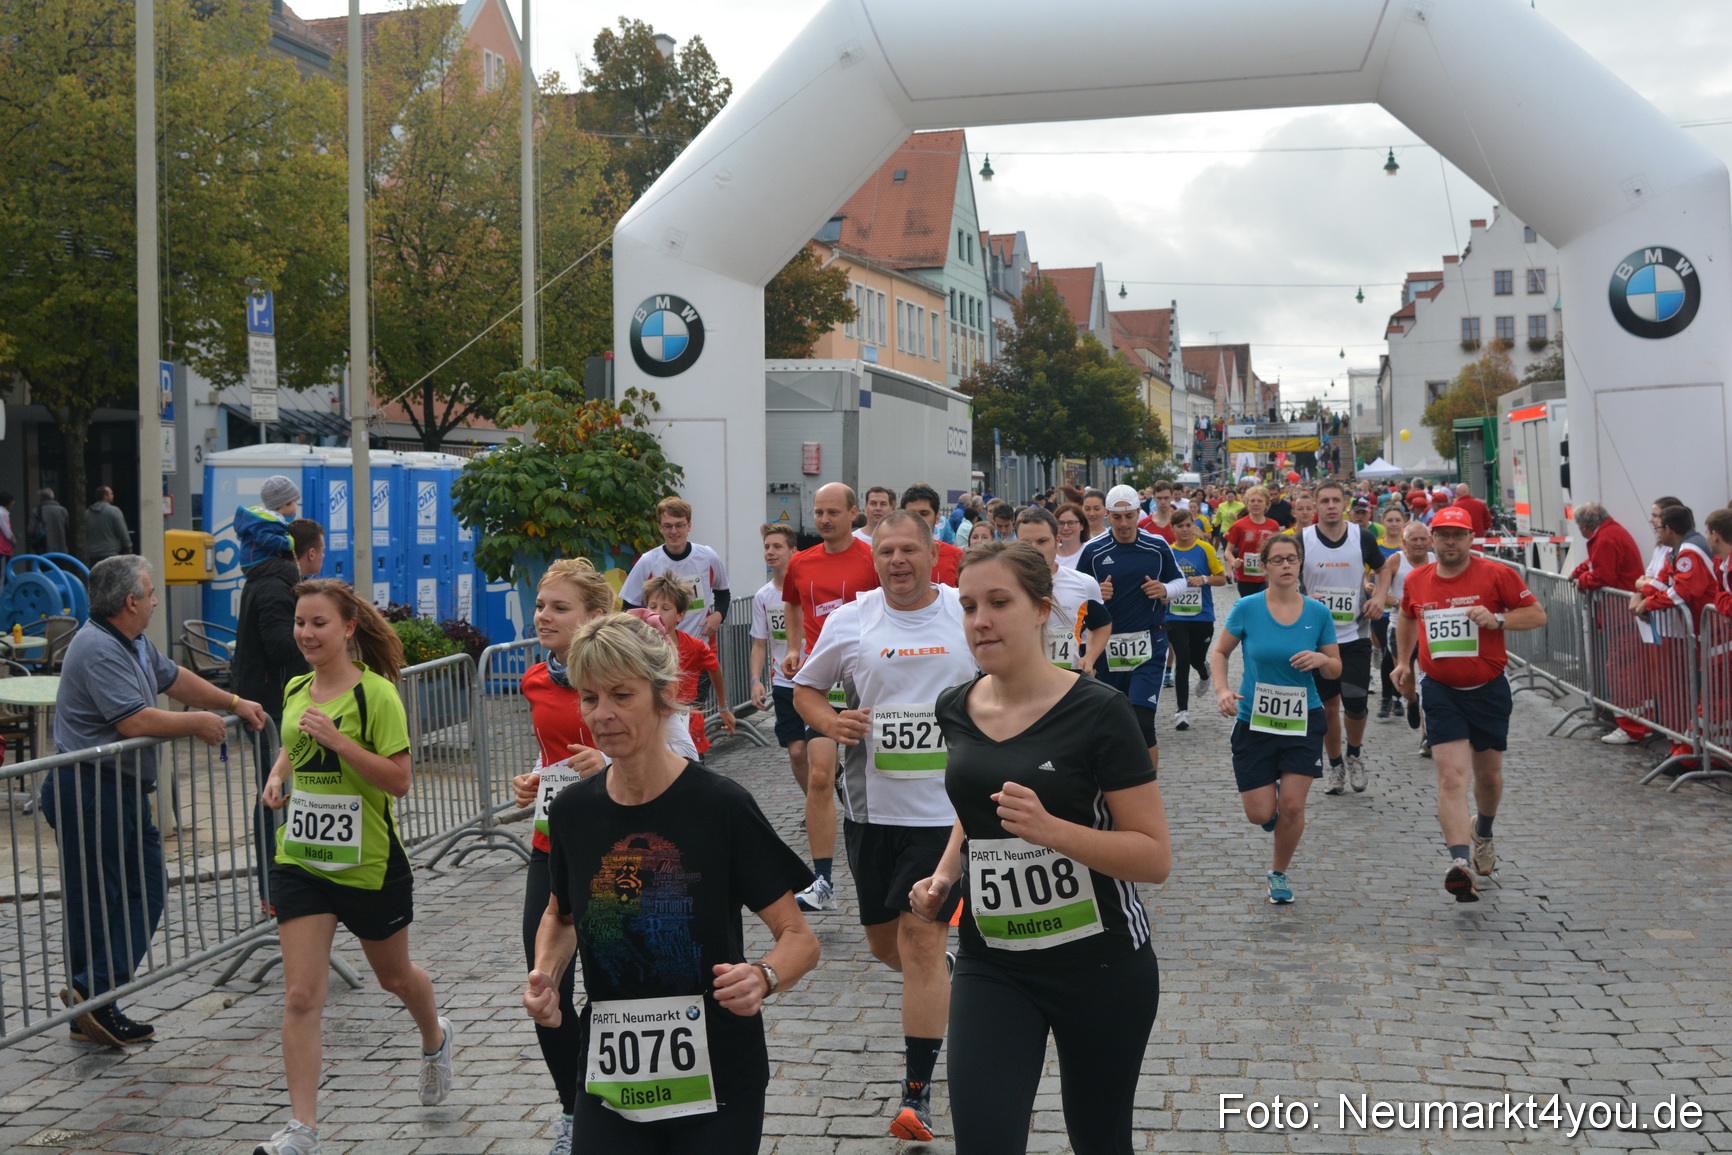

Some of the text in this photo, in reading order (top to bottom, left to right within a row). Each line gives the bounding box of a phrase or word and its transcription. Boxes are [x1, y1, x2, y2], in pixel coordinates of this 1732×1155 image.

[1616, 248, 1694, 281] BMW
[634, 296, 699, 325] BMW
[1257, 441, 1289, 449] START
[1429, 619, 1471, 639] 5551
[898, 646, 950, 657] KLEBL
[1109, 640, 1147, 657] 5012
[1258, 695, 1303, 717] 5014
[875, 711, 902, 719] PARTL
[1270, 719, 1288, 728] Lena
[881, 721, 946, 750] 5527
[541, 774, 558, 782] PARTL
[291, 797, 347, 810] PARTL Neumarkt
[291, 810, 353, 842] 5023
[304, 846, 333, 862] Nadja
[971, 851, 1002, 861] PARTL
[980, 857, 1080, 911] 5108
[654, 897, 693, 913] FUTURITY
[1007, 916, 1063, 936] Andrea
[592, 1010, 681, 1024] PARTL Neumarkt
[598, 1026, 696, 1075] 5076
[620, 1085, 672, 1106] Gisela
